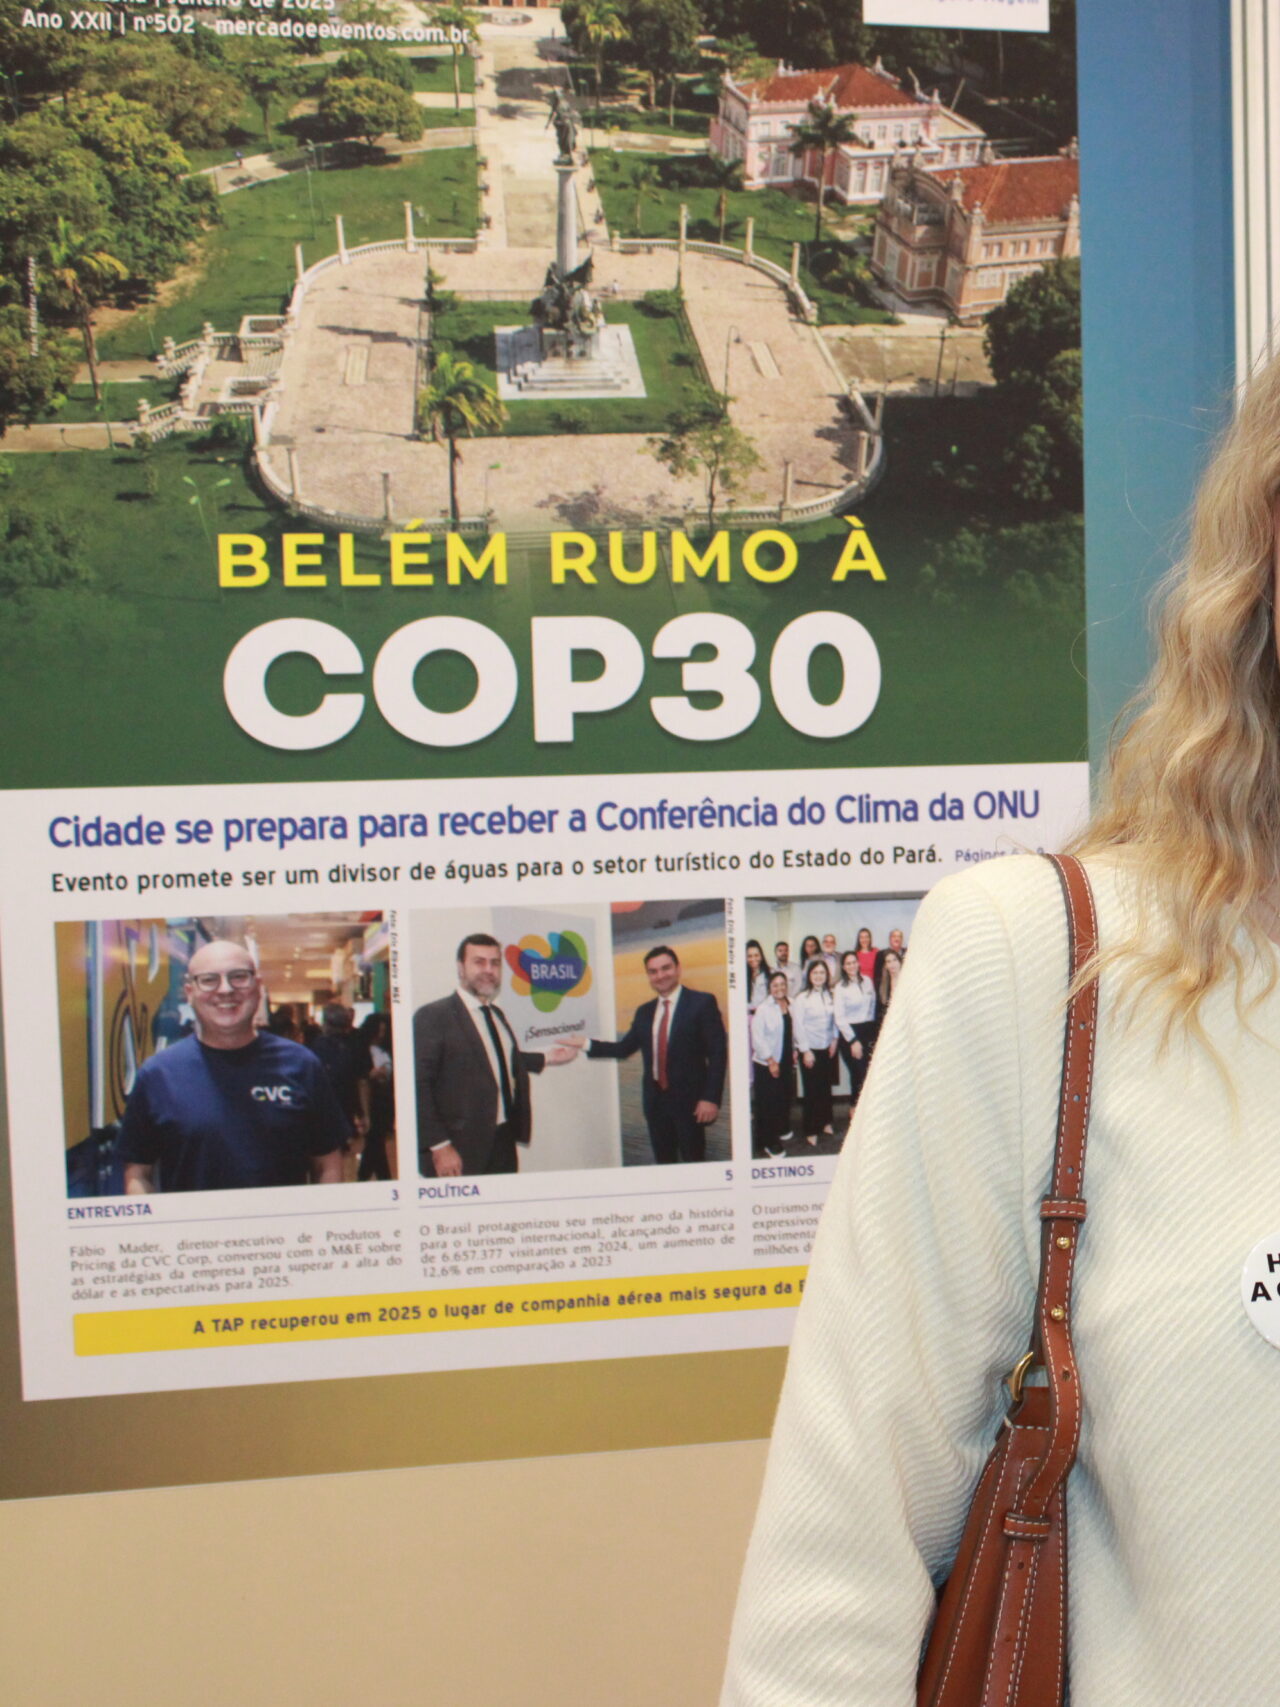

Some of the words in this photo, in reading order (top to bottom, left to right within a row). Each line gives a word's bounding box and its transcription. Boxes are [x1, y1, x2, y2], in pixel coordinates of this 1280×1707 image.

[22, 8, 63, 29] Ano
[70, 10, 112, 31] XXII
[215, 18, 470, 43] mercadoeeventos.com.br
[217, 519, 507, 588] BELÉM
[550, 530, 798, 584] RUMO
[831, 515, 887, 581] À
[223, 611, 881, 751] COP30
[49, 815, 165, 848] Cidade
[175, 818, 212, 844] se
[224, 814, 347, 851] prepara
[359, 812, 428, 847] para
[439, 804, 558, 836] receber
[569, 809, 586, 832] a
[596, 796, 778, 832] Conferência
[788, 797, 825, 825] do
[836, 793, 918, 824] Clima
[928, 792, 964, 821] da
[973, 790, 1040, 820] ONU
[52, 872, 128, 892] Evento
[138, 868, 232, 894] promete
[242, 868, 276, 887] ser
[285, 867, 318, 885] um
[328, 863, 400, 883] divisor
[410, 862, 435, 880] de
[445, 860, 508, 884] águas
[516, 860, 563, 881] para
[572, 860, 584, 875] o
[593, 856, 646, 875] setor
[655, 852, 741, 873] turístico
[750, 850, 774, 869] do
[783, 846, 851, 867] Estado
[860, 846, 884, 865] do
[892, 844, 943, 864] Pará.
[530, 963, 578, 979] BRASIL
[251, 1086, 291, 1101] CVC
[725, 1169, 733, 1181] 5
[751, 1165, 815, 1179] DESTINOS
[391, 1189, 399, 1201] 3
[418, 1183, 480, 1199] POLÍTICA
[67, 1203, 153, 1220] ENTREVISTA
[764, 1203, 809, 1215] turismo
[436, 1222, 471, 1235] Brasil
[478, 1218, 560, 1234] protagonizou
[565, 1217, 586, 1226] seu
[592, 1213, 634, 1225] melhor
[641, 1213, 663, 1222] ano
[669, 1209, 683, 1221] da
[689, 1207, 734, 1219] história
[752, 1216, 819, 1230] expressivos
[69, 1246, 106, 1257] Fábio
[177, 1235, 285, 1251] diretor-executivo
[297, 1232, 312, 1244] de
[326, 1229, 381, 1242] Produtos
[420, 1240, 447, 1251] para
[467, 1235, 515, 1247] turismo
[611, 1223, 680, 1238] alcançando
[698, 1222, 735, 1232] marca
[70, 1260, 116, 1273] Pricing
[121, 1258, 137, 1269] da
[141, 1255, 171, 1268] CVC
[217, 1251, 282, 1263] conversou
[287, 1248, 313, 1259] com
[331, 1244, 363, 1256] M&E
[368, 1242, 402, 1254] sobre
[420, 1253, 436, 1264] de
[442, 1248, 503, 1262] 6.657.377
[509, 1246, 567, 1258] visitantes
[573, 1245, 592, 1254] em
[638, 1240, 657, 1250] um
[663, 1236, 715, 1248] aumento
[720, 1233, 735, 1245] de
[753, 1244, 799, 1256] milhões
[71, 1276, 85, 1286] as
[92, 1271, 162, 1285] estratégias
[169, 1269, 185, 1280] da
[192, 1266, 245, 1279] empresa
[253, 1265, 281, 1277] para
[288, 1261, 334, 1275] superar
[356, 1257, 379, 1268] alta
[386, 1256, 402, 1267] do
[466, 1265, 485, 1275] em
[489, 1259, 565, 1274] comparação
[582, 1255, 612, 1268] 2023
[71, 1289, 104, 1301] dólar
[122, 1287, 136, 1297] as
[141, 1281, 220, 1297] expectativas
[225, 1280, 253, 1292] para
[1251, 1281, 1272, 1302] A
[193, 1320, 205, 1334] A
[212, 1317, 244, 1332] TAP
[251, 1313, 339, 1332] recuperou
[346, 1311, 371, 1324] em
[378, 1305, 422, 1322] 2025
[428, 1306, 437, 1319] o
[444, 1302, 487, 1319] lugar
[494, 1300, 514, 1314] de
[521, 1292, 610, 1313] companhia
[617, 1290, 662, 1306] aérea
[670, 1286, 706, 1302] mais
[713, 1282, 767, 1300] segura
[774, 1281, 792, 1295] da
